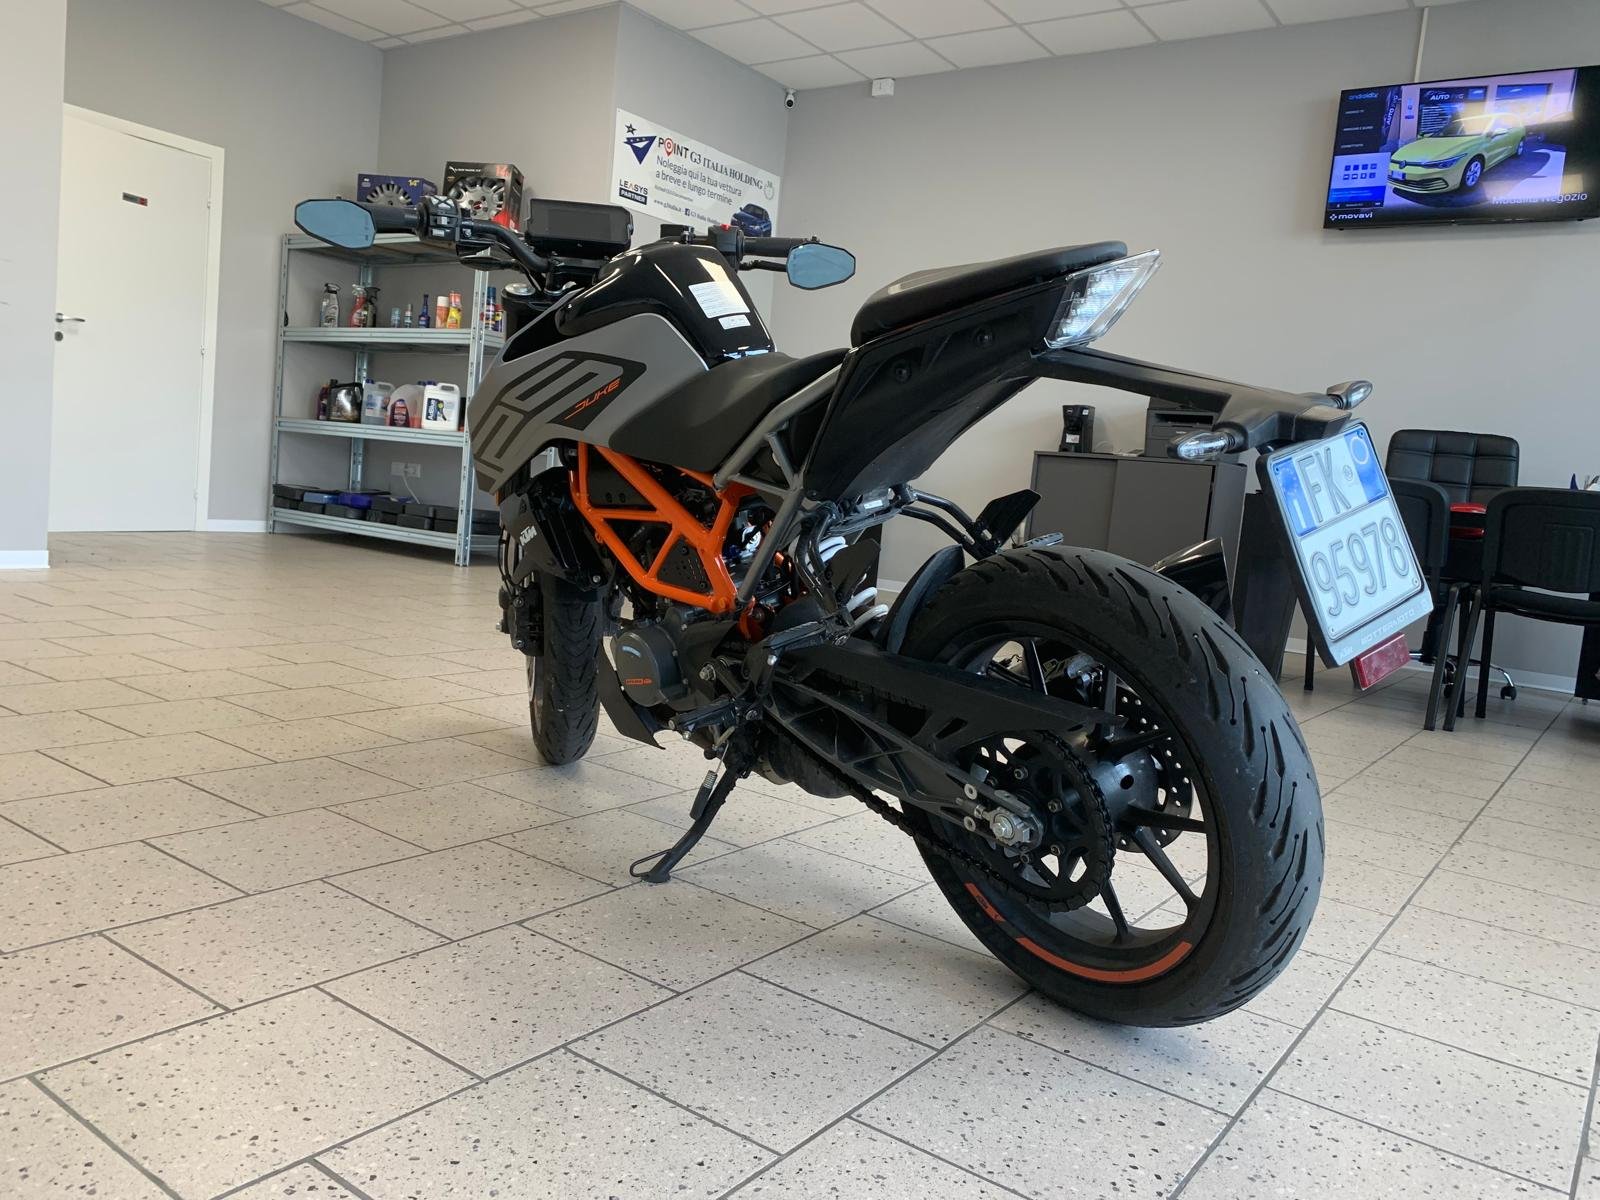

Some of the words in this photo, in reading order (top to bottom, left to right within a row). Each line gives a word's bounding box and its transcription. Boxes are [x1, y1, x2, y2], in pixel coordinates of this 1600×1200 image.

[656, 155, 687, 176] Noleggia
[688, 169, 699, 181] qui
[699, 172, 706, 183] la
[707, 175, 718, 187] tua
[719, 181, 742, 197] vettura
[658, 137, 689, 159] POINT
[690, 151, 702, 165] G3
[703, 157, 729, 176] ITALIA
[729, 168, 763, 190] HOLDING
[660, 170, 682, 188] breve
[687, 180, 706, 196] lungo
[707, 187, 733, 206] termine
[564, 378, 621, 420] DUKE
[1297, 446, 1351, 523] FK
[519, 525, 537, 546] KTM
[1310, 517, 1409, 617] 95978
